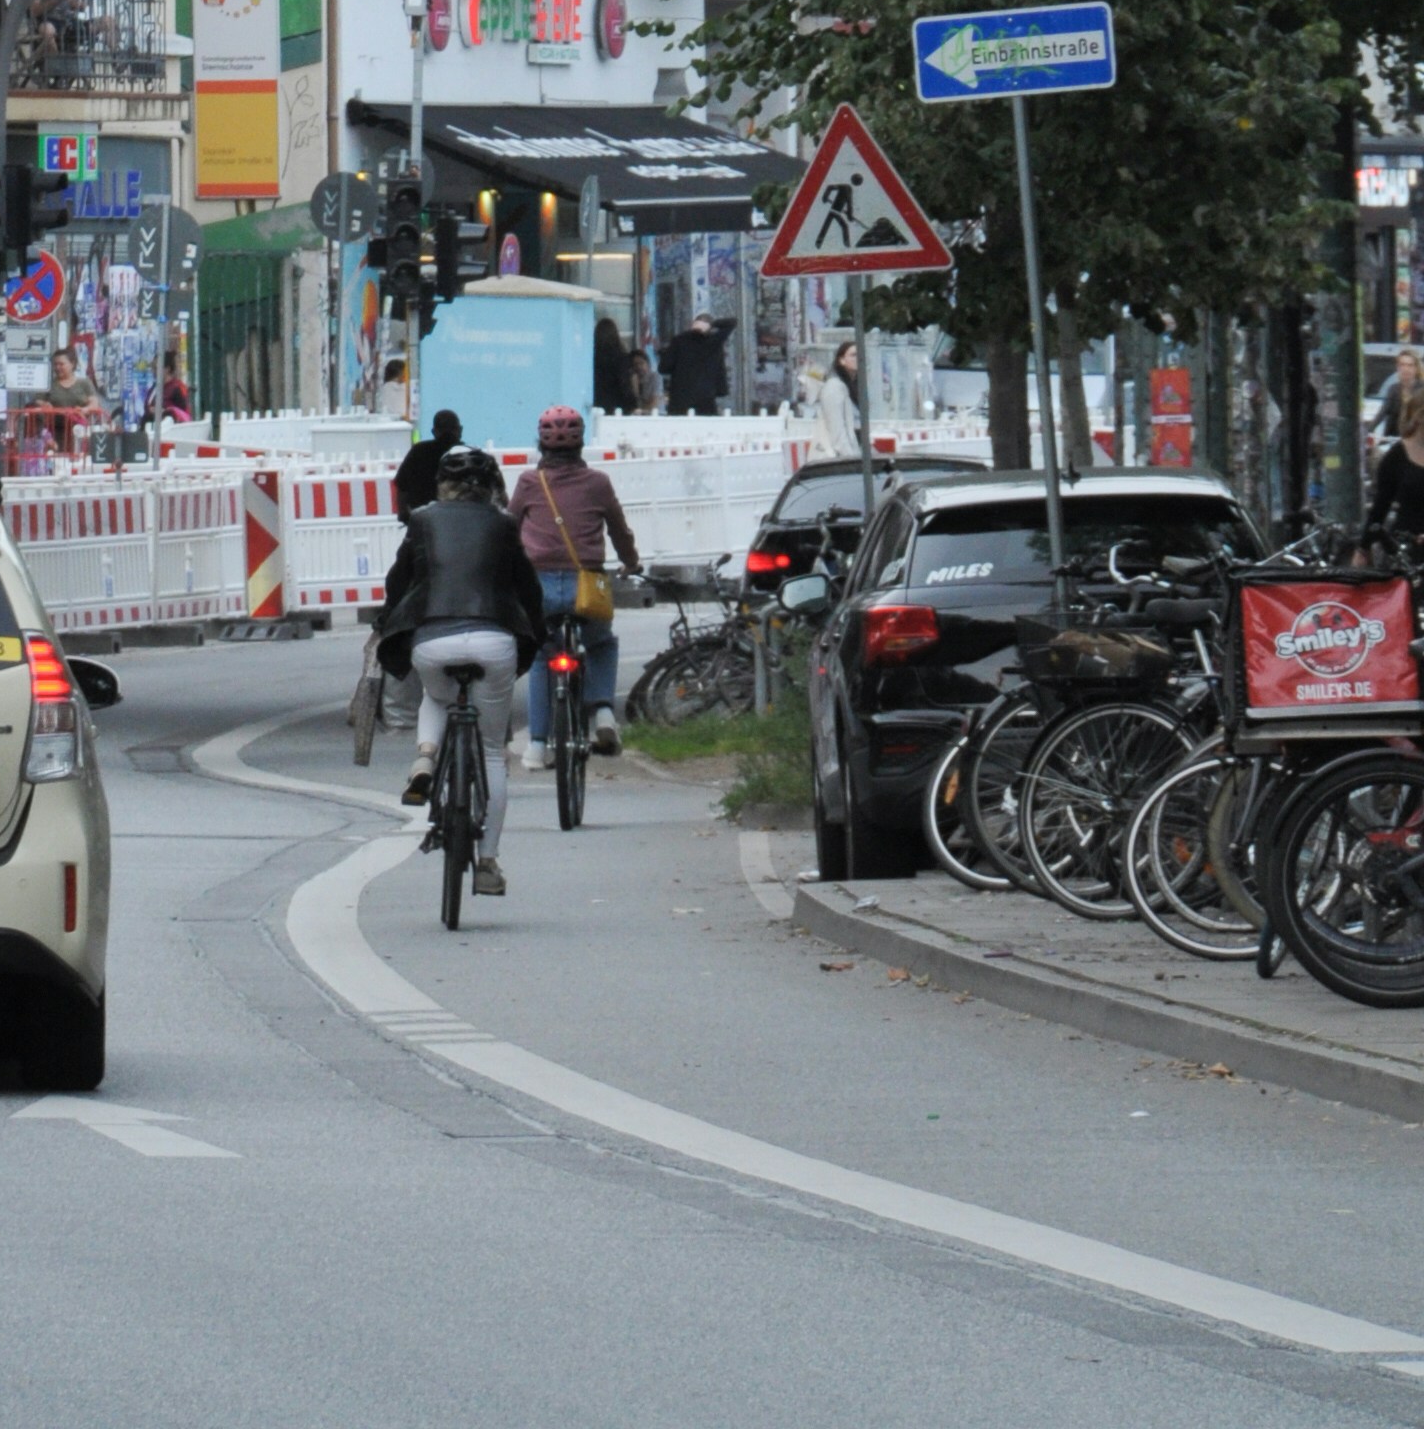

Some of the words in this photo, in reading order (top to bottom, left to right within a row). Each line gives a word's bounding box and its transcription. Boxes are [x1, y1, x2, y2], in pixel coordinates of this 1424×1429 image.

[972, 38, 1100, 65] Einbahnstraße
[926, 562, 994, 585] MILES
[1276, 619, 1385, 658] Smiley's
[1296, 681, 1373, 701] SMILEYS.DE
